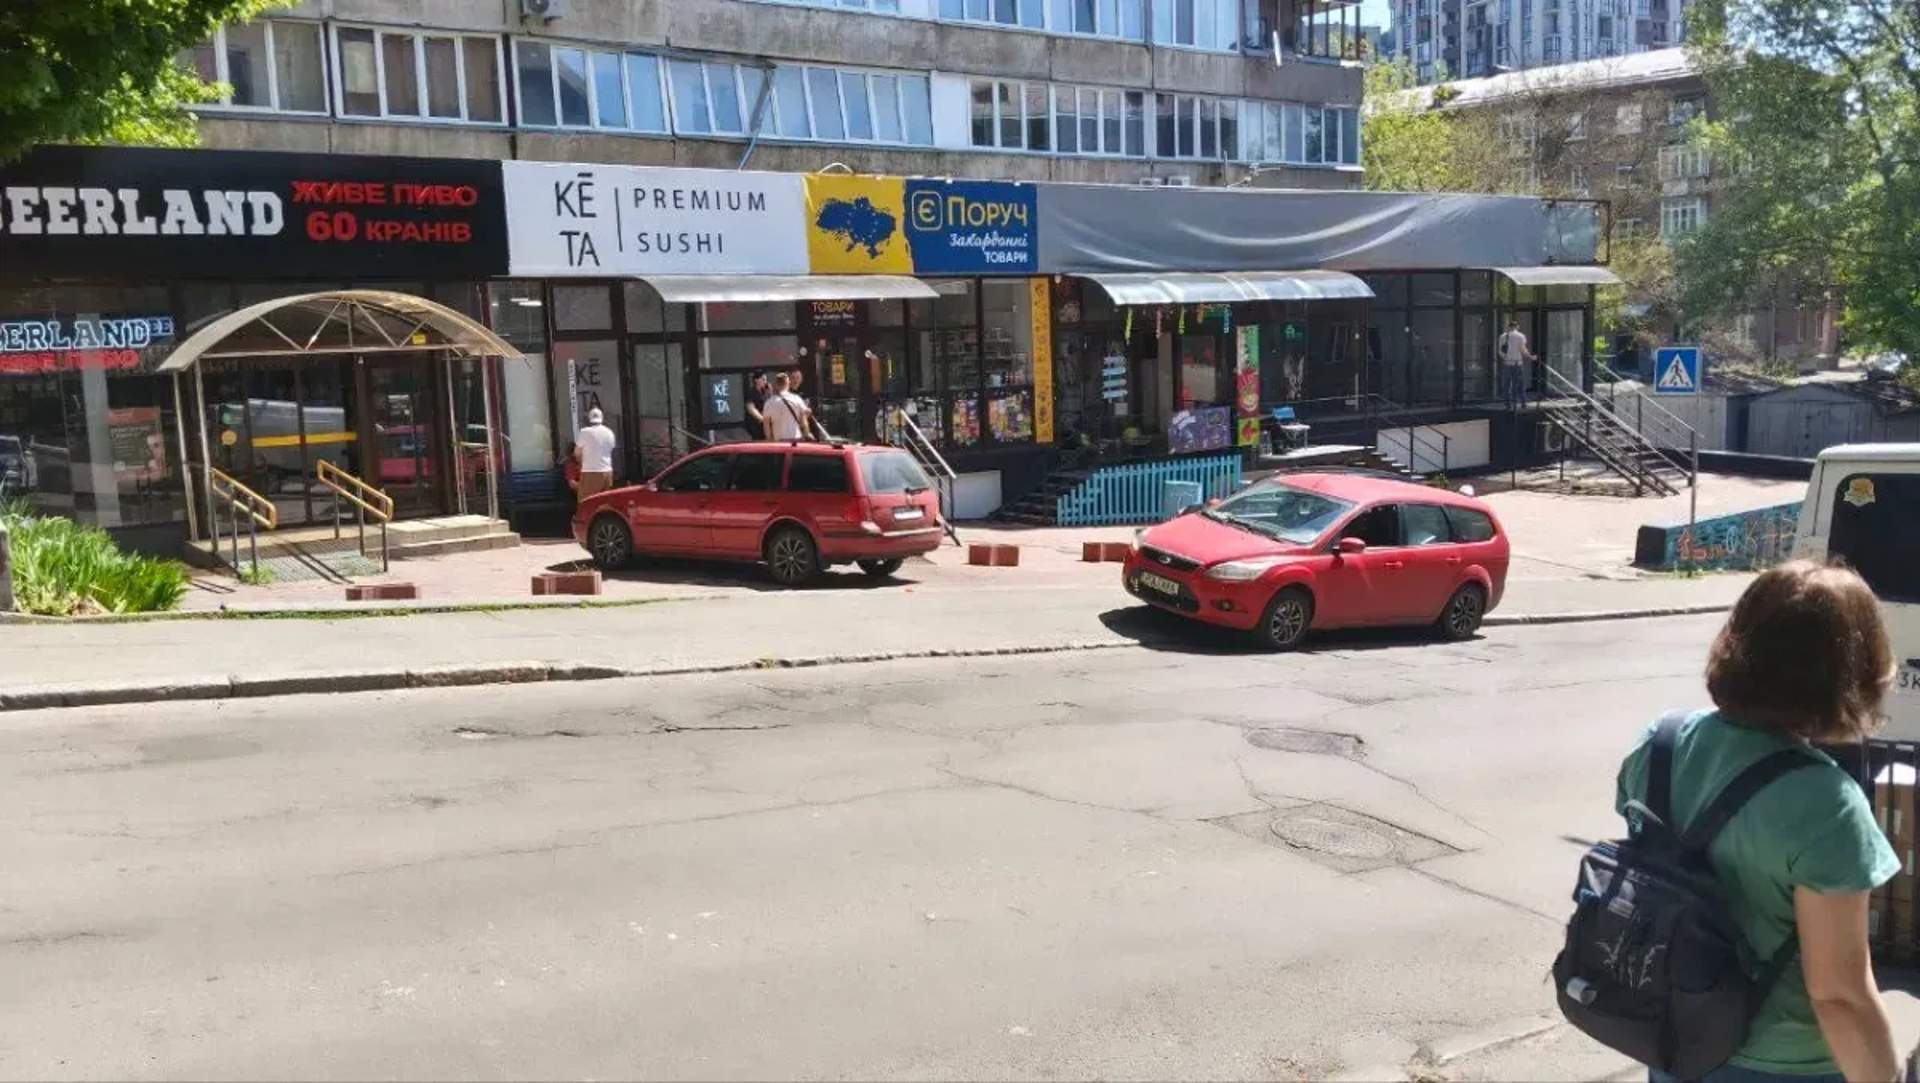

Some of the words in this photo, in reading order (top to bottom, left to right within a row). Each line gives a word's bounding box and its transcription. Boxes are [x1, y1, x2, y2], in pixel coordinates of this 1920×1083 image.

[291, 181, 386, 205] ЖИВЕ
[393, 184, 478, 207] ПИВО
[633, 187, 766, 211] PREMIUM
[0, 187, 284, 235] EERLAND
[306, 211, 358, 241] 60
[366, 221, 472, 242] КРАНІВ
[560, 231, 600, 267] TA
[637, 232, 724, 253] SUSHI
[983, 250, 1028, 264] ТОВАРИ
[811, 301, 855, 313] ТОВАРИ
[0, 319, 151, 350] ERLAND
